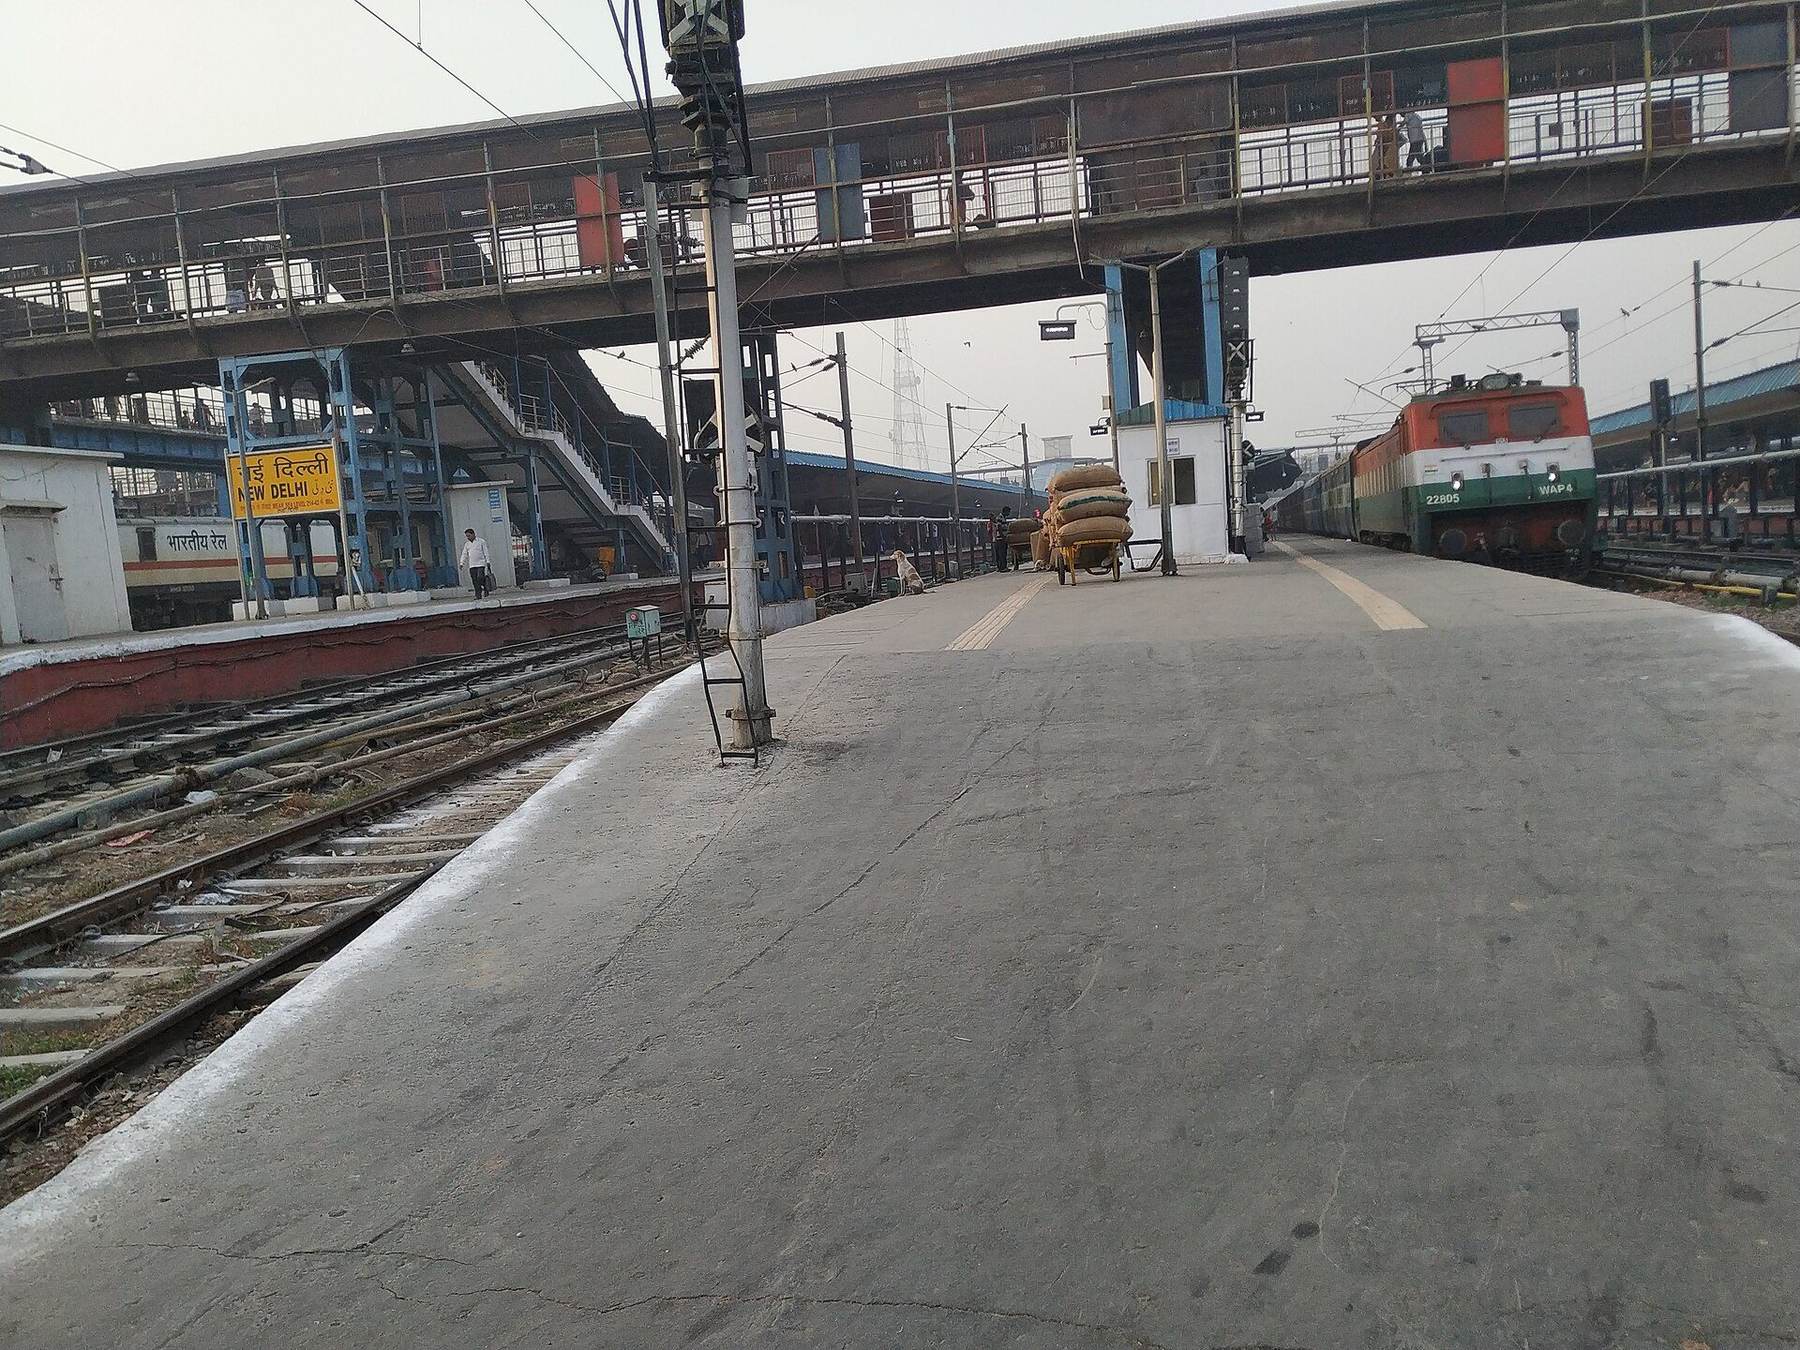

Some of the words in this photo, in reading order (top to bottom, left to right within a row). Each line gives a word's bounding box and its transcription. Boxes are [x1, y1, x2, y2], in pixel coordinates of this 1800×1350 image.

[273, 452, 328, 478] दिल्ली
[238, 485, 265, 502] NEW
[271, 481, 308, 499] DELHI
[1426, 493, 1460, 505] 22805
[1539, 483, 1573, 496] WAP4
[167, 529, 209, 551] भारतीय
[210, 530, 227, 550] रेल
